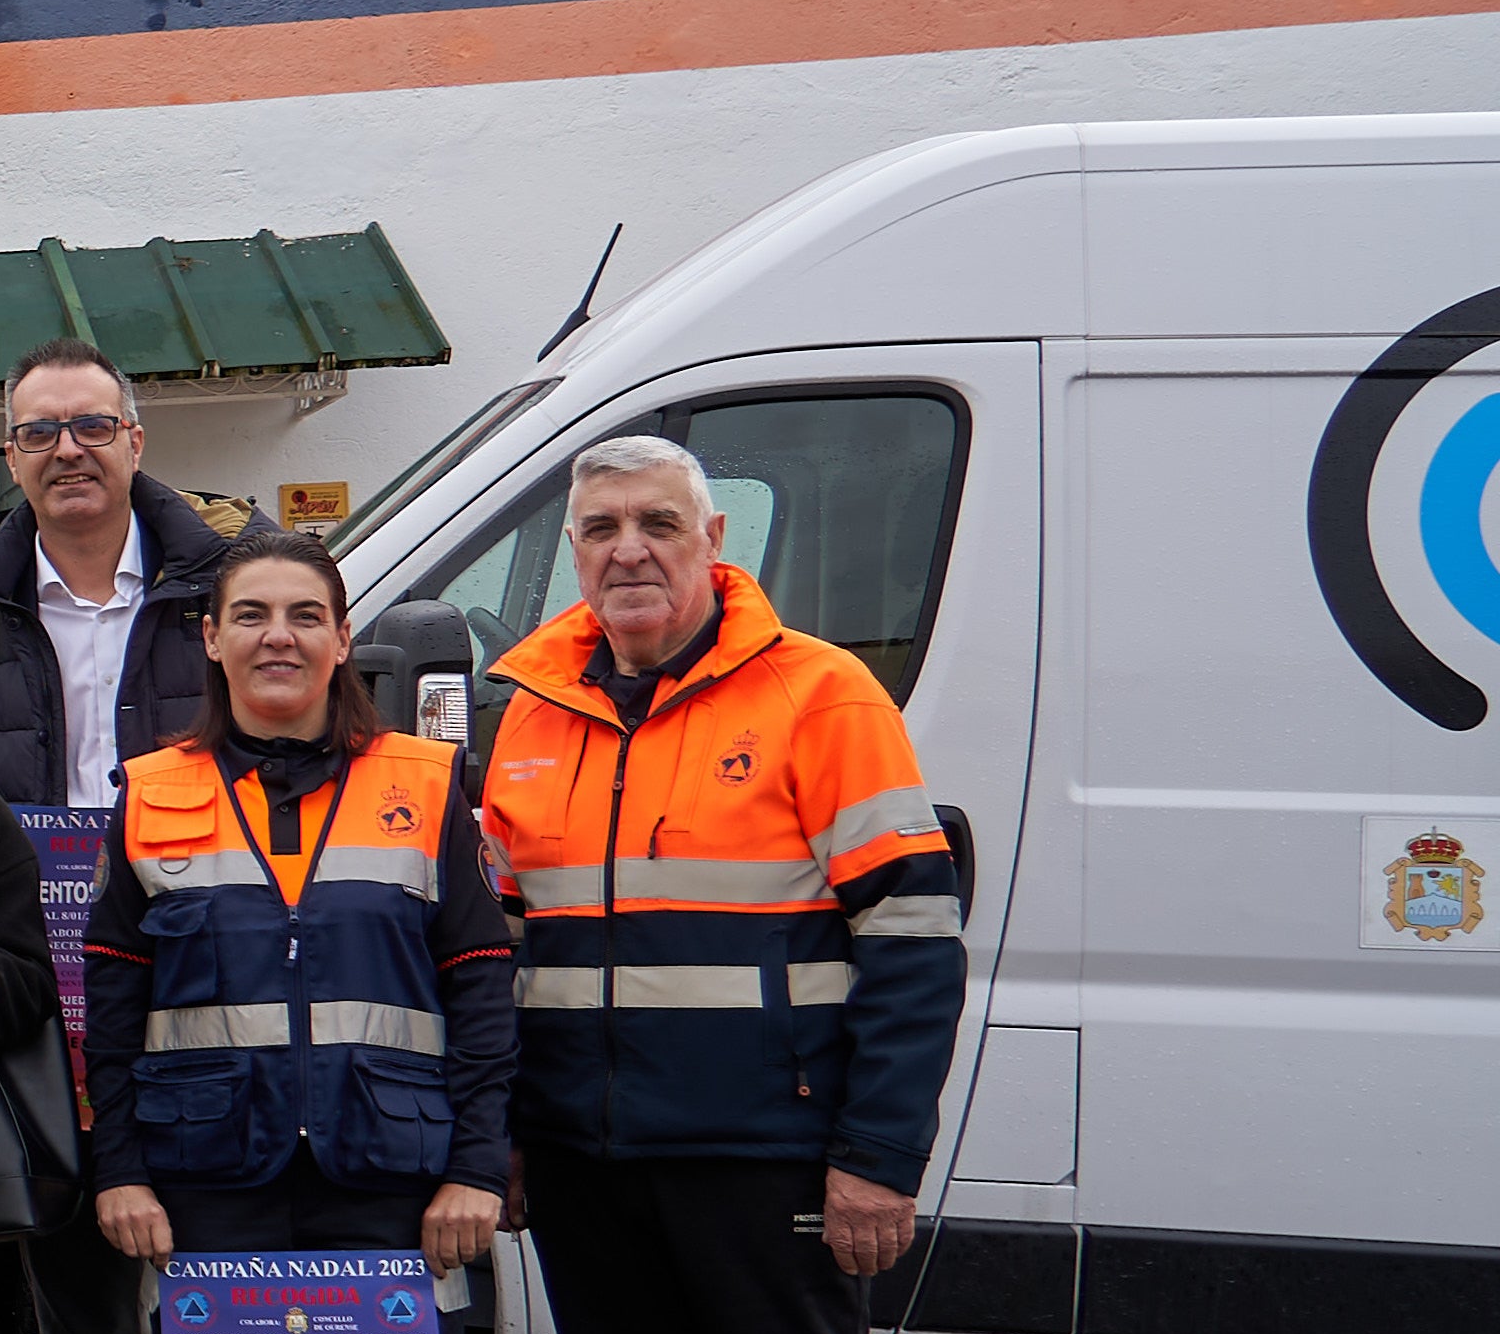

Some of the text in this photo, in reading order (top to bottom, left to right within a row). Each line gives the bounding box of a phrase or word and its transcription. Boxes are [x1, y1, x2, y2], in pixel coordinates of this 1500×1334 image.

[21, 812, 98, 829] MPAÑA
[164, 1257, 427, 1277] CAMPAÑA NADAL 2023
[230, 1286, 360, 1305] RECOGIDA
